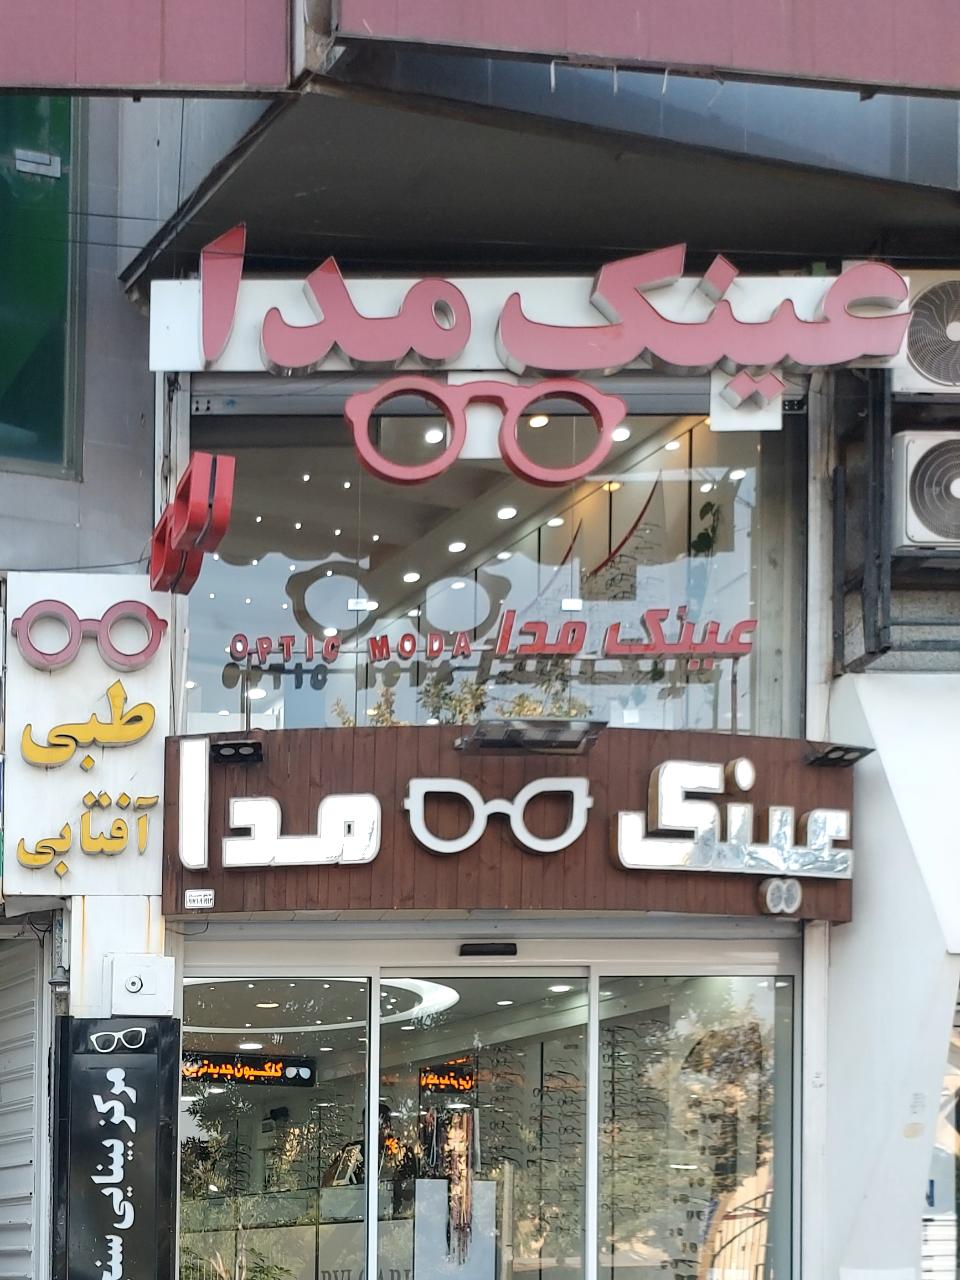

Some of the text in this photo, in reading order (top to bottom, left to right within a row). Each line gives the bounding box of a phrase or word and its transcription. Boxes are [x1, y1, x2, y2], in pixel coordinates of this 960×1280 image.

[199, 222, 911, 409] عینک مدا
[229, 633, 472, 664] OPTIC MODA
[495, 606, 759, 670] عینک مدا
[21, 679, 156, 772] طبی
[16, 791, 160, 878] آفتابی
[178, 737, 854, 915] عینک مدا
[92, 1067, 137, 1133] مرکز
[235, 1062, 283, 1080] کلکسیون
[90, 1138, 135, 1230] بینایی
